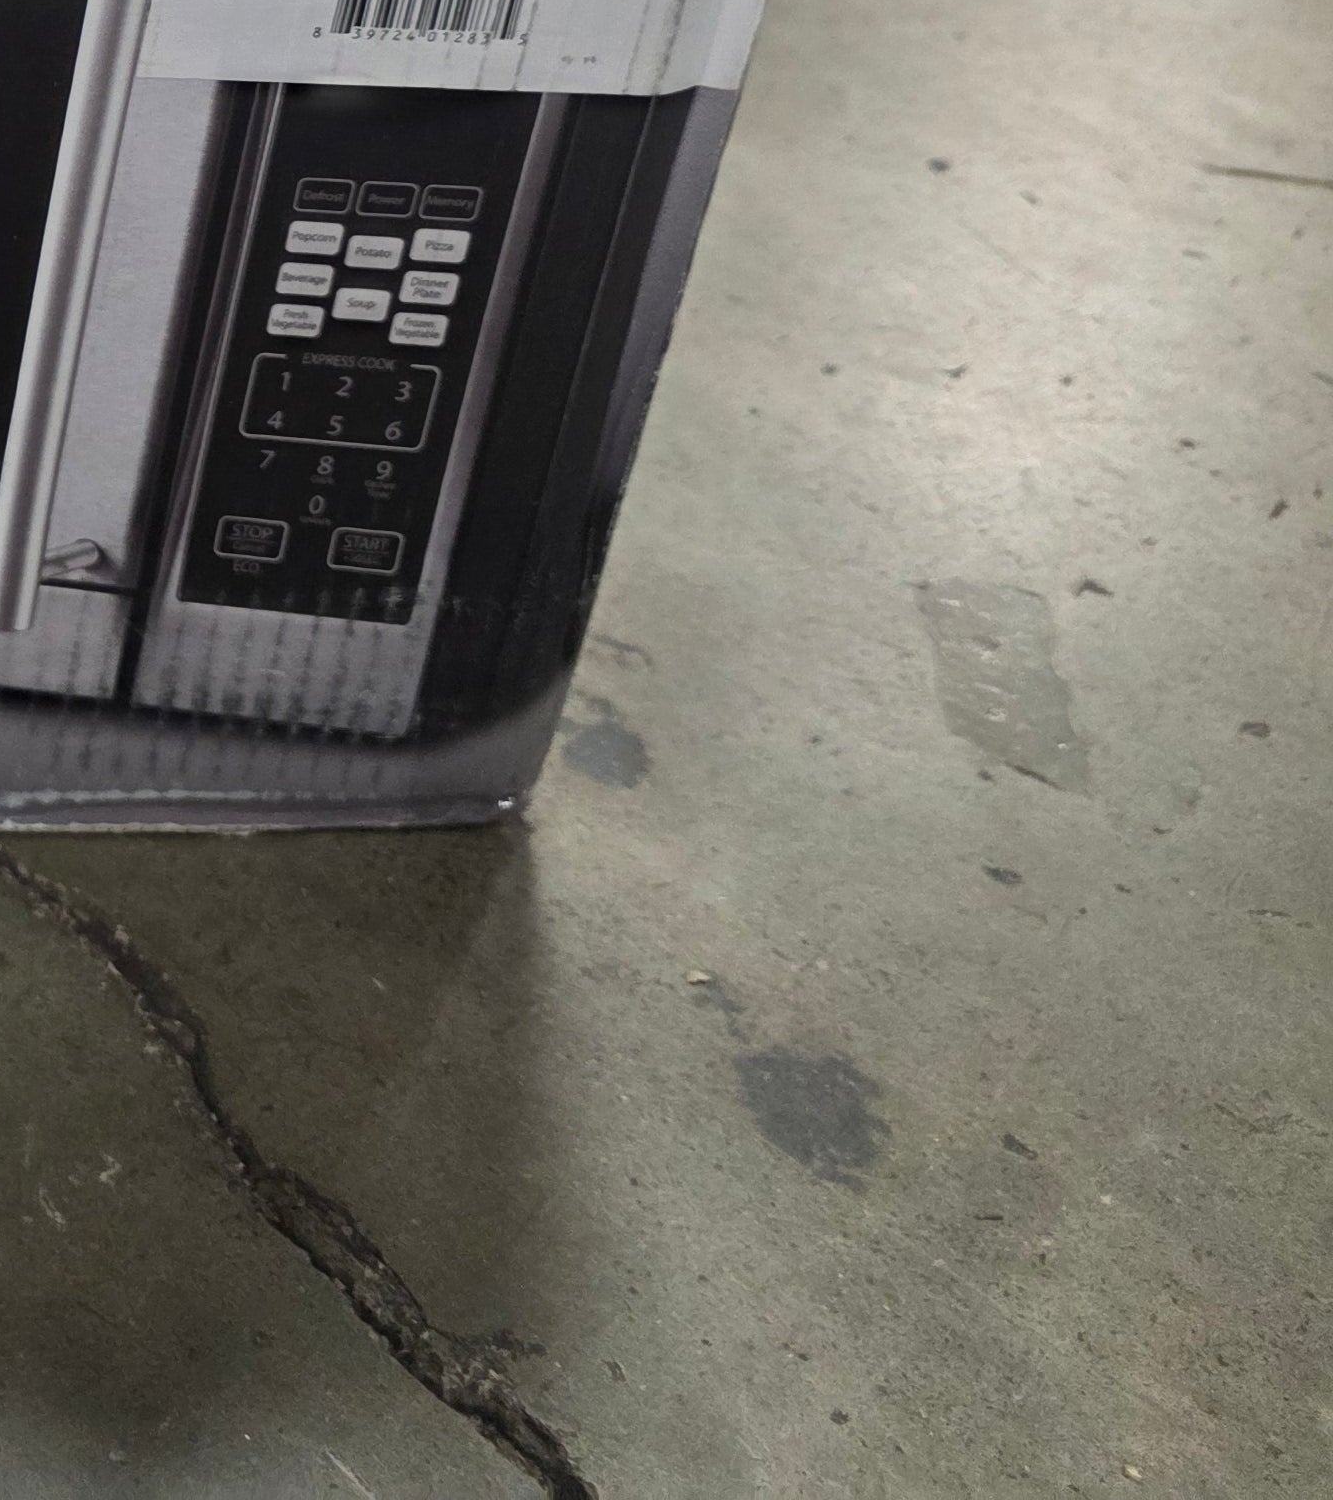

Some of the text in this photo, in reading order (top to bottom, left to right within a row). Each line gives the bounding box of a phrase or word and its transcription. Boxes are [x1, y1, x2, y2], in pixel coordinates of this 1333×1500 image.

[293, 230, 337, 244] Popcorn
[282, 272, 328, 285] Beverage
[301, 352, 355, 368] EXPRESS
[280, 371, 413, 401] 1 2 3
[267, 410, 403, 440] 4 5 6
[259, 449, 393, 480] 7 8 9
[309, 495, 326, 515] 0
[232, 524, 274, 538] STOP
[344, 536, 390, 550] START
